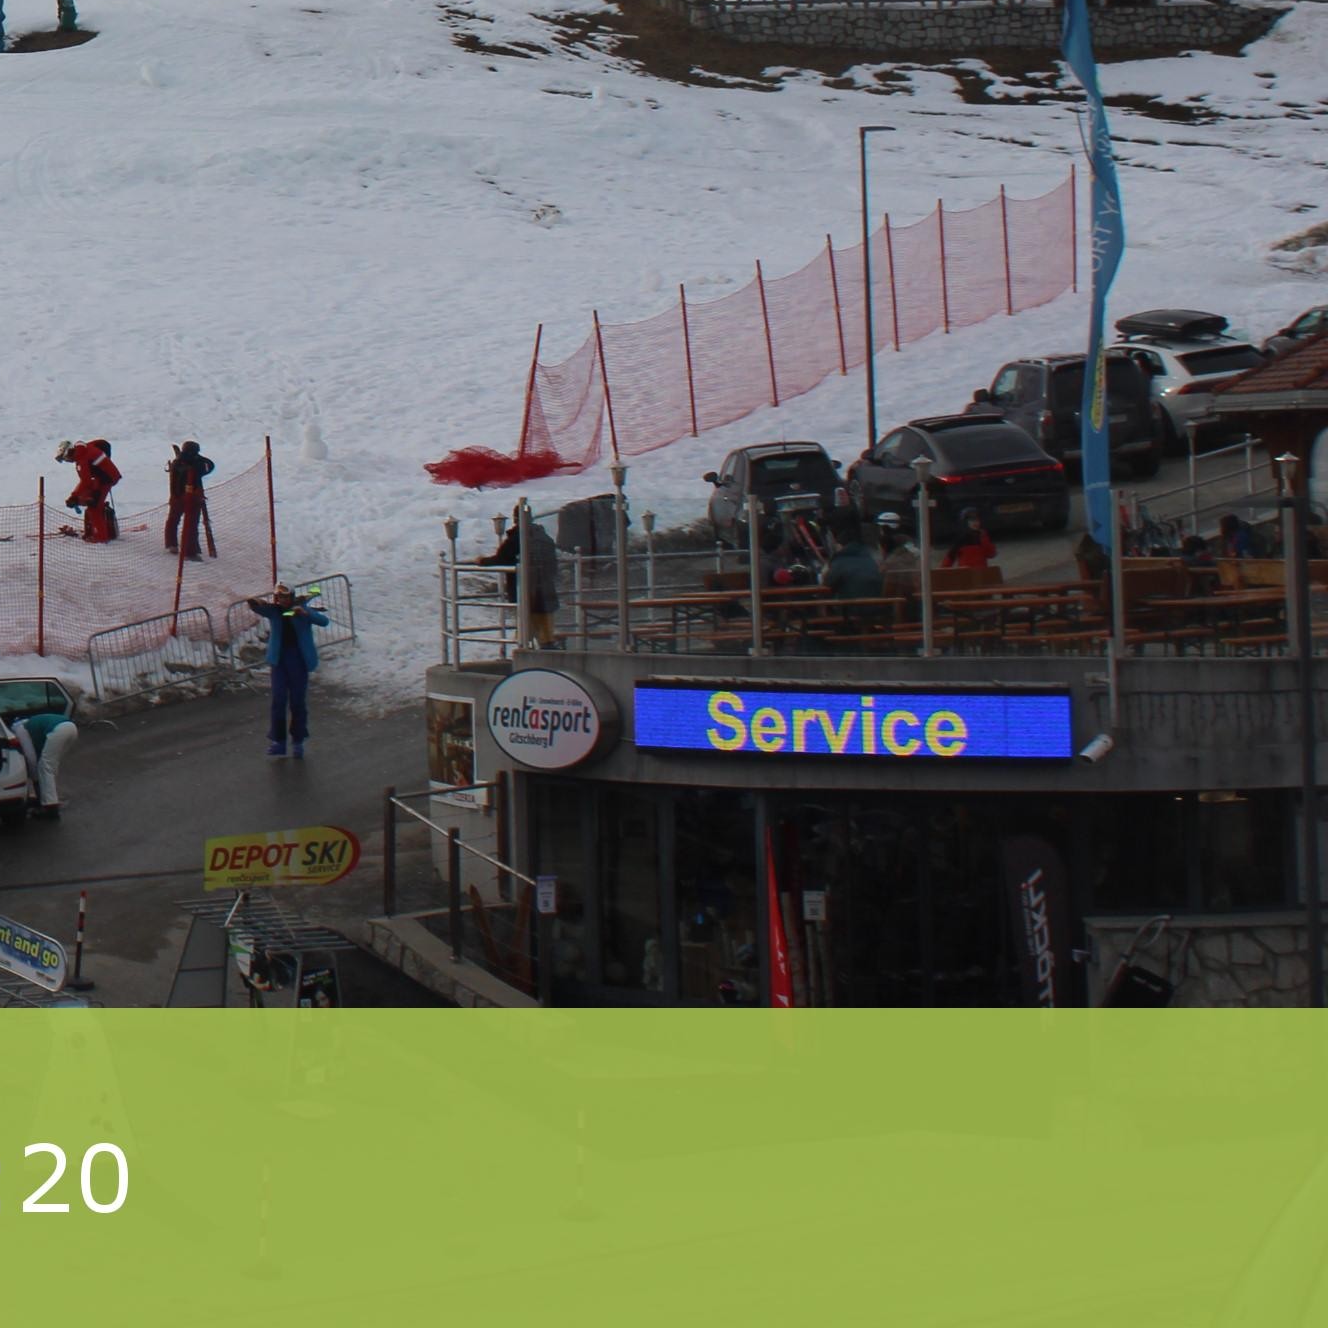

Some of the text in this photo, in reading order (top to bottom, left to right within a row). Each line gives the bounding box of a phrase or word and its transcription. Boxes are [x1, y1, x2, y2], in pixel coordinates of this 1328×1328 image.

[492, 695, 592, 747] rentasport
[706, 691, 968, 757] Service
[209, 840, 348, 871] DEPOT SKI
[14, 936, 40, 958] and
[42, 949, 58, 967] go
